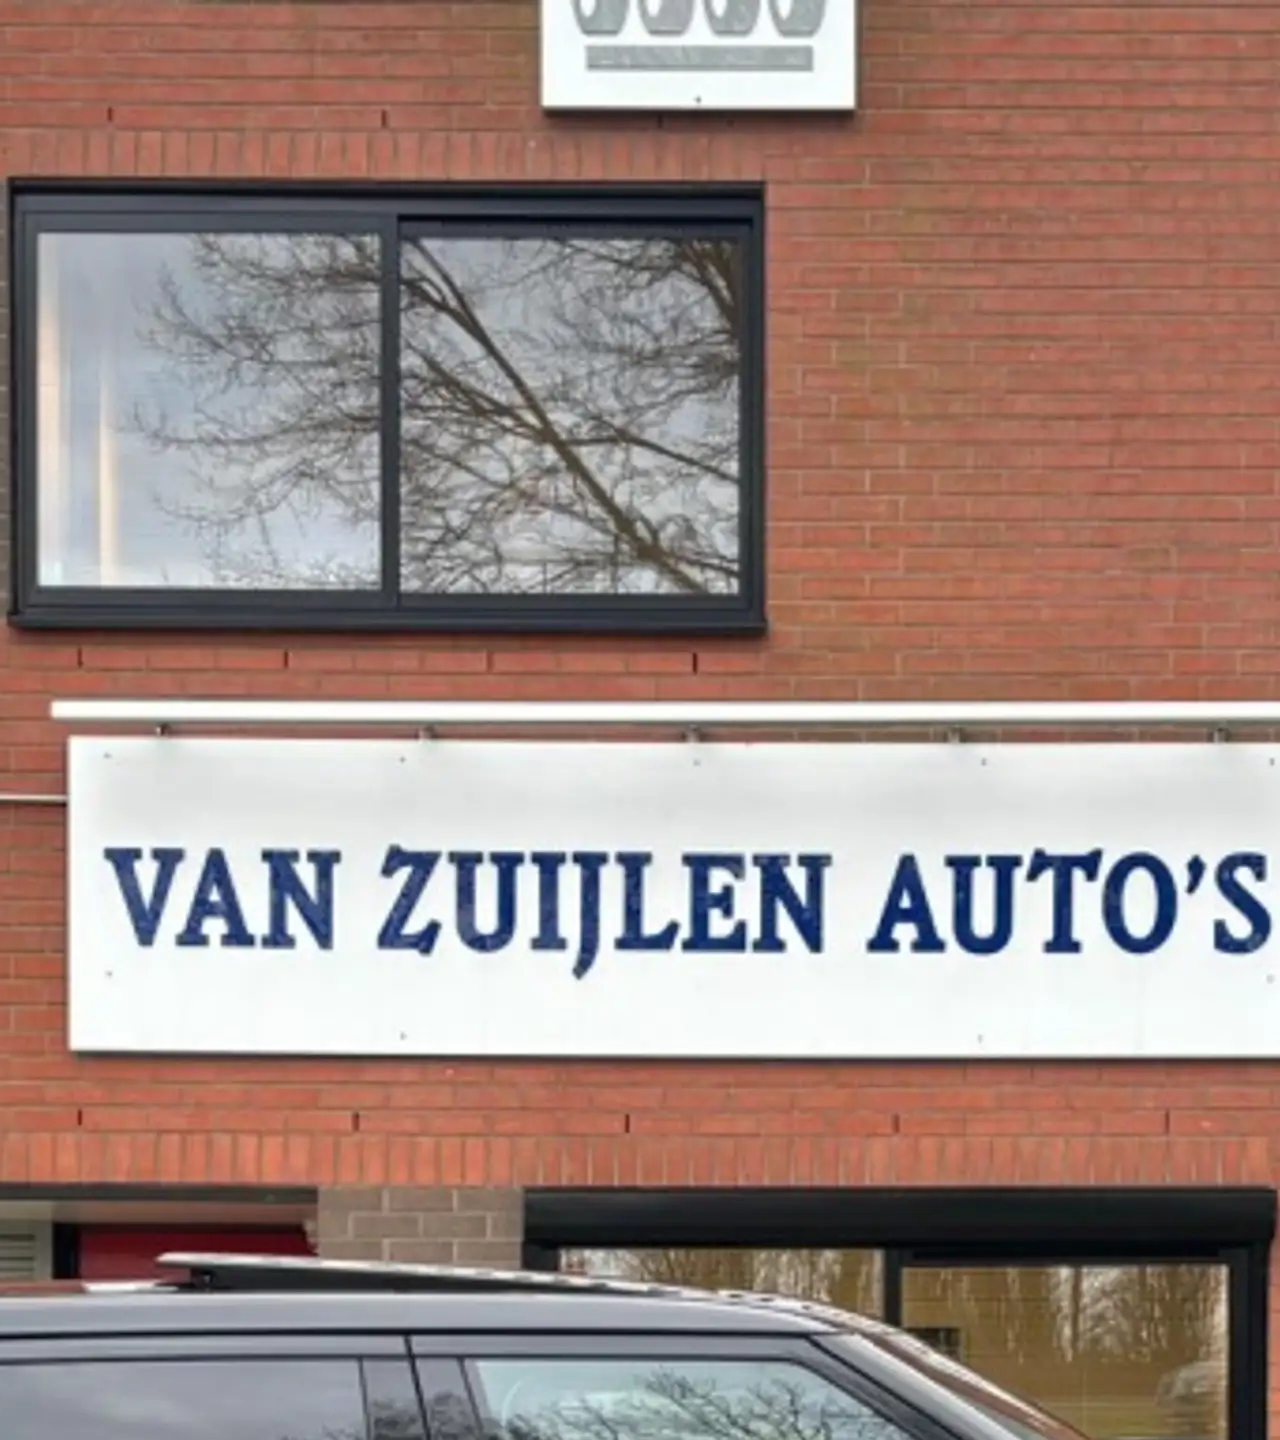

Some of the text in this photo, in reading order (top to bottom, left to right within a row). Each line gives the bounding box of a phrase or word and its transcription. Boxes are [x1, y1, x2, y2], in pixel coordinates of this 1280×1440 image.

[104, 845, 1272, 979] VAN ZUIJLEN AUTO'S
